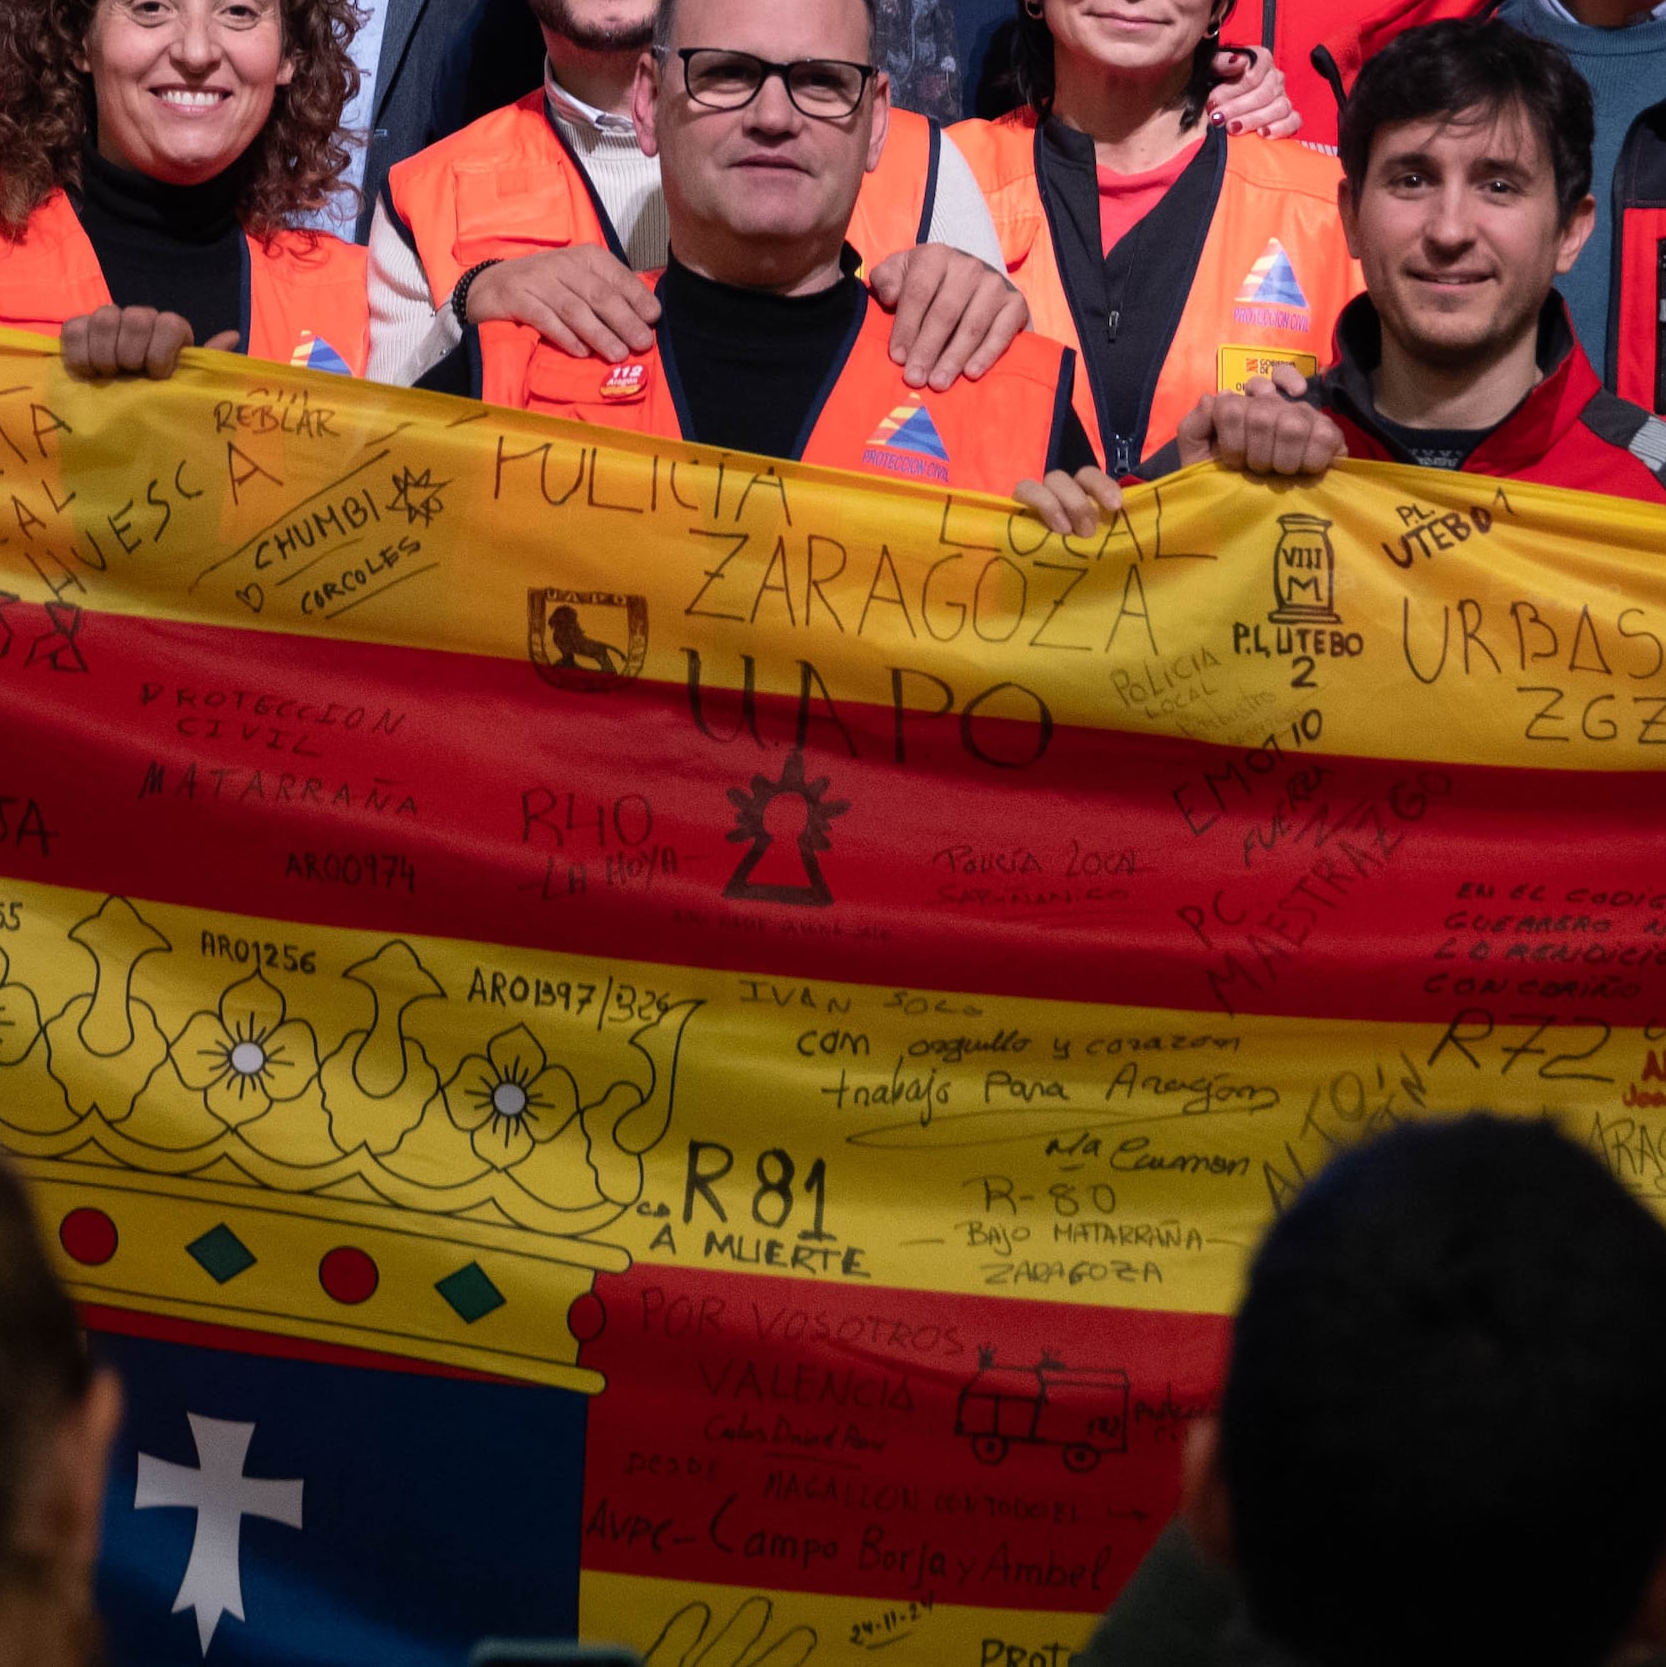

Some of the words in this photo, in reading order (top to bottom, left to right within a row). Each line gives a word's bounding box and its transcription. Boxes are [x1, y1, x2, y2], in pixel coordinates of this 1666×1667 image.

[23, 439, 284, 602] HUESCA
[683, 527, 1160, 657] ZARAGOZA
[1286, 573, 1323, 603] M
[1277, 625, 1365, 658] UTEBO
[1290, 655, 1320, 689] 2
[138, 681, 408, 737] PROTECCION
[175, 714, 325, 759] CIVIL
[136, 759, 421, 818] MATARRAÑA
[648, 1232, 679, 1257] A
[703, 1230, 872, 1278] MUERTE
[697, 1359, 916, 1413] VALENCIA
[982, 1544, 1113, 1592] Ambel
